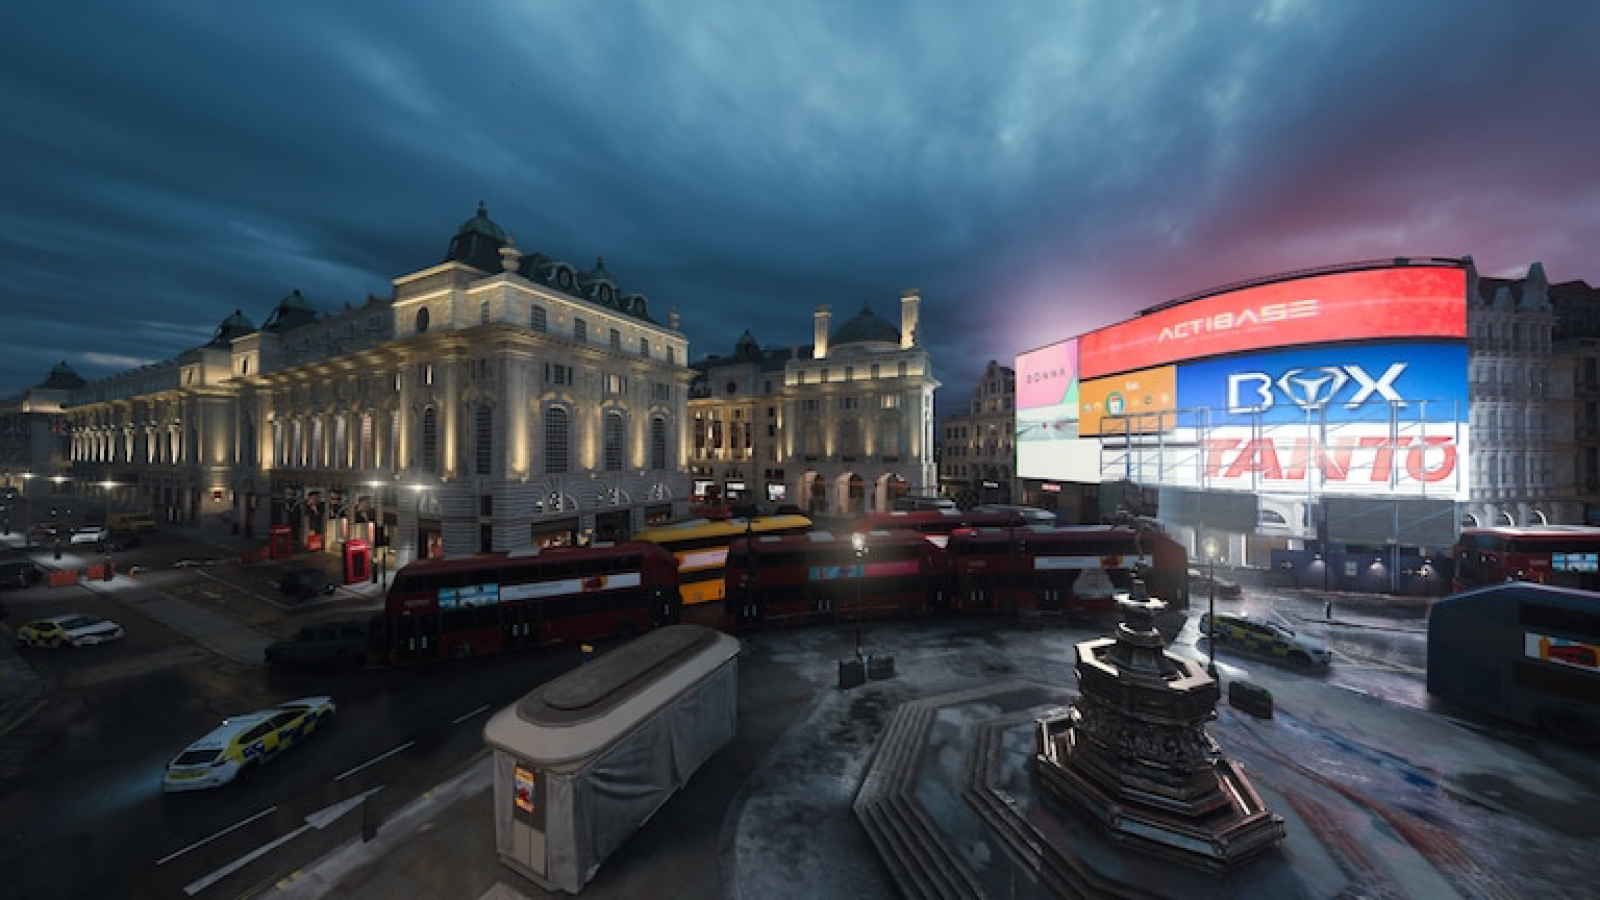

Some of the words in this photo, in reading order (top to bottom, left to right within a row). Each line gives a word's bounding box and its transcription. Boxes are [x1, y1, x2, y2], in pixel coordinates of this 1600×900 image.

[1158, 299, 1320, 342] ACTIBASE
[1228, 362, 1408, 413] BOX
[1198, 435, 1457, 482] TANTO
